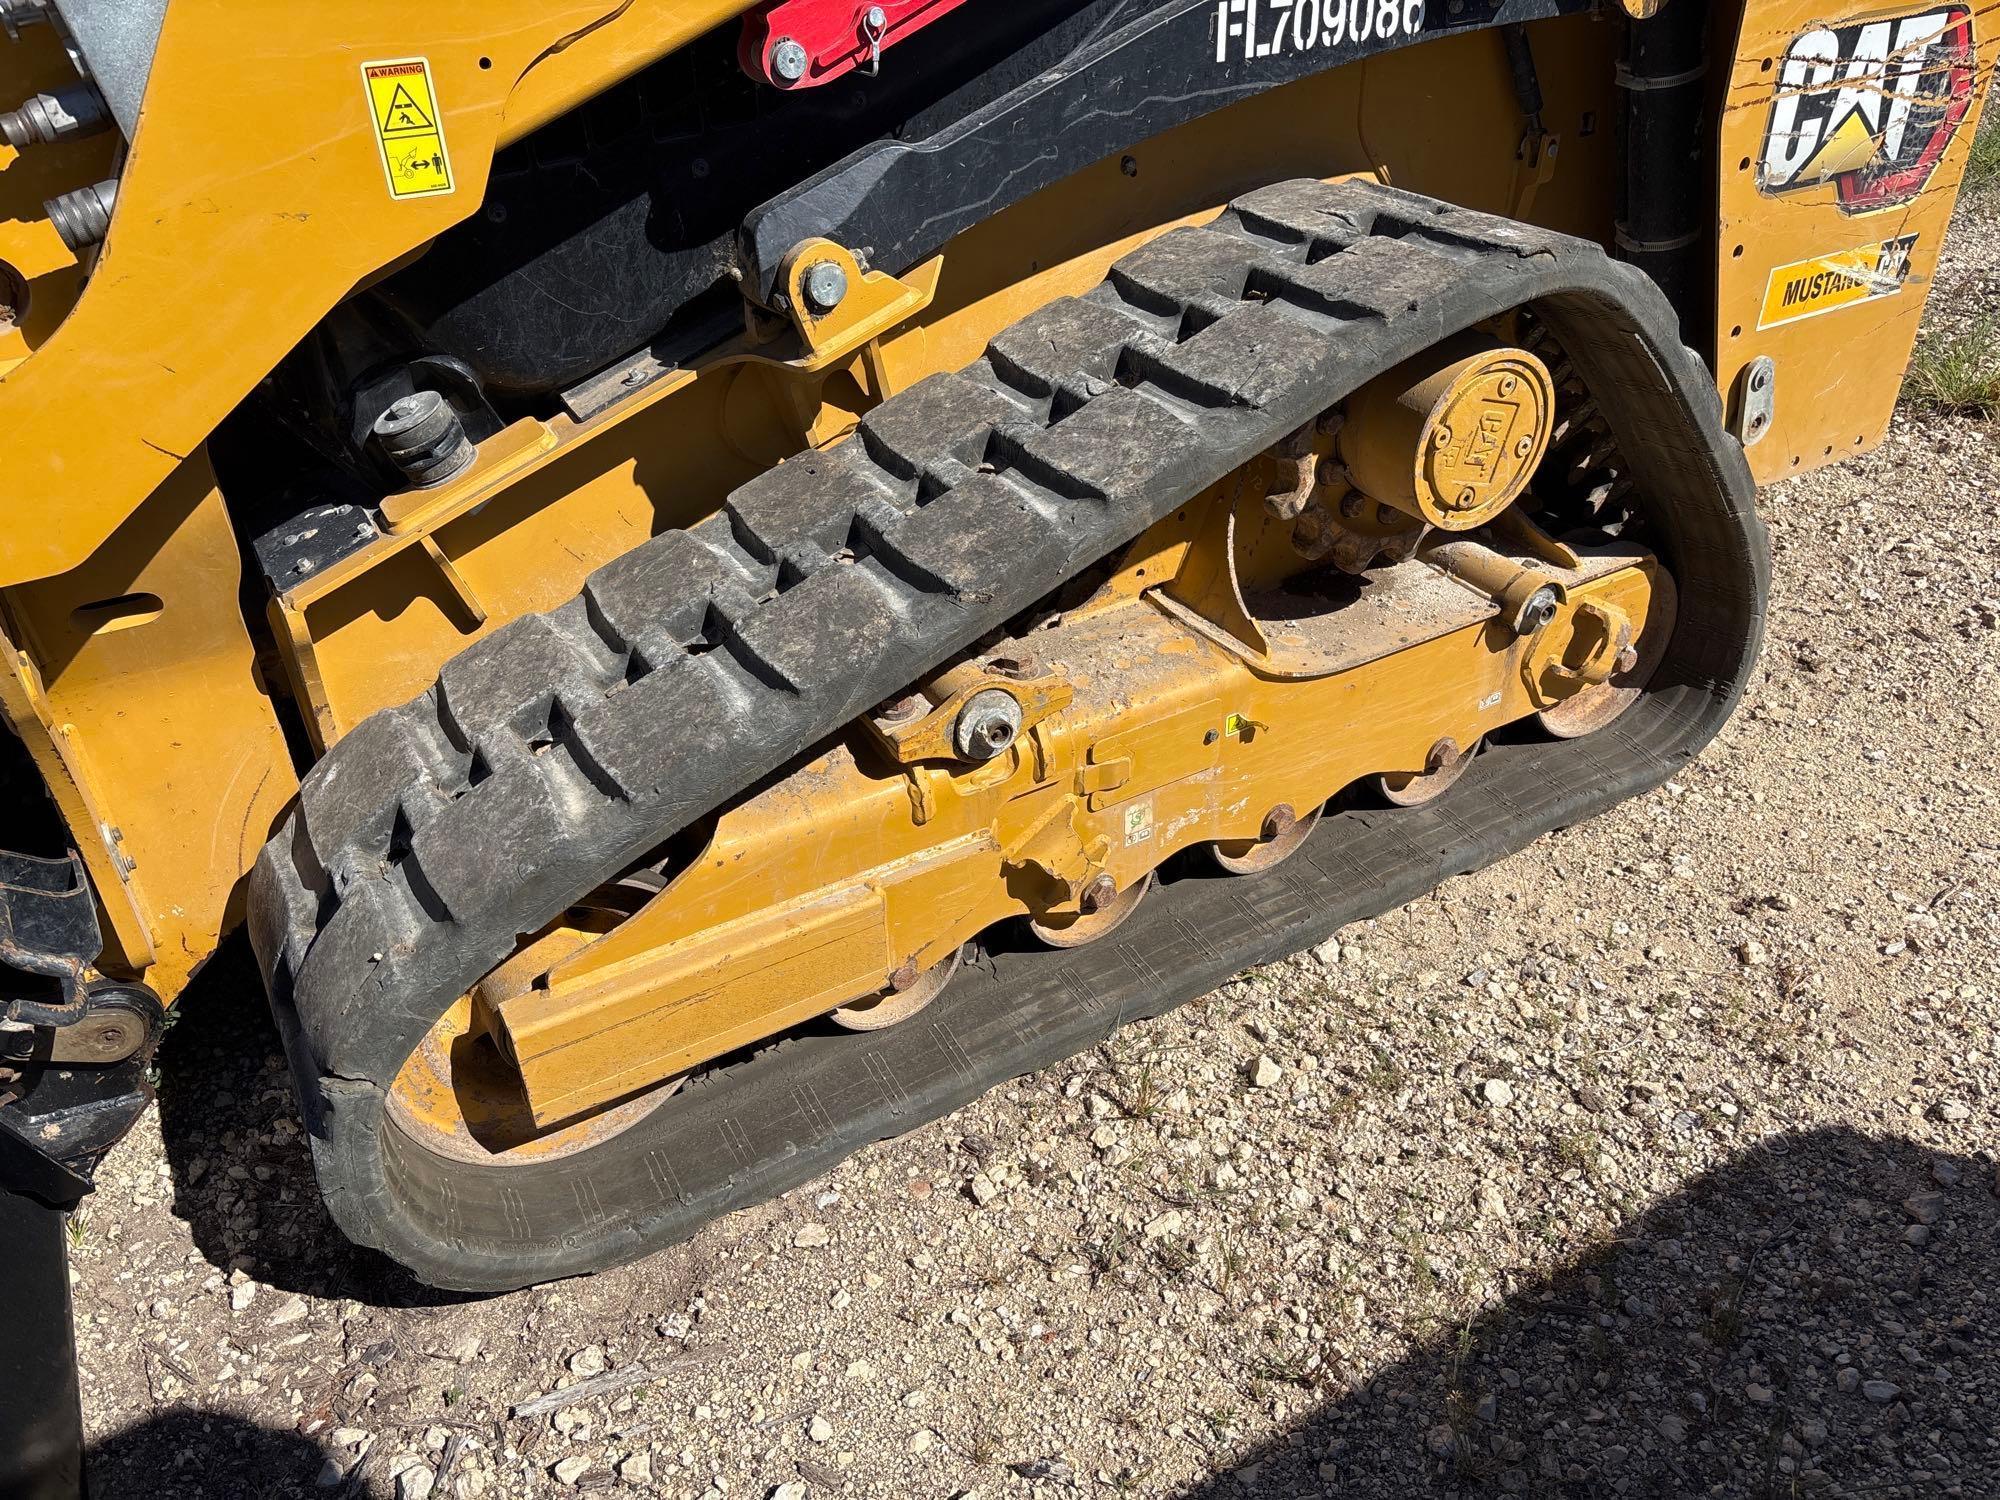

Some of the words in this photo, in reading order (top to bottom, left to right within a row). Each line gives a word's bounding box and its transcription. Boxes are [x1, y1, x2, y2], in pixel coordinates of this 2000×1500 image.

[1216, 0, 1426, 63] FL709086
[379, 65, 423, 77] WARNING
[1763, 12, 1949, 186] CAT
